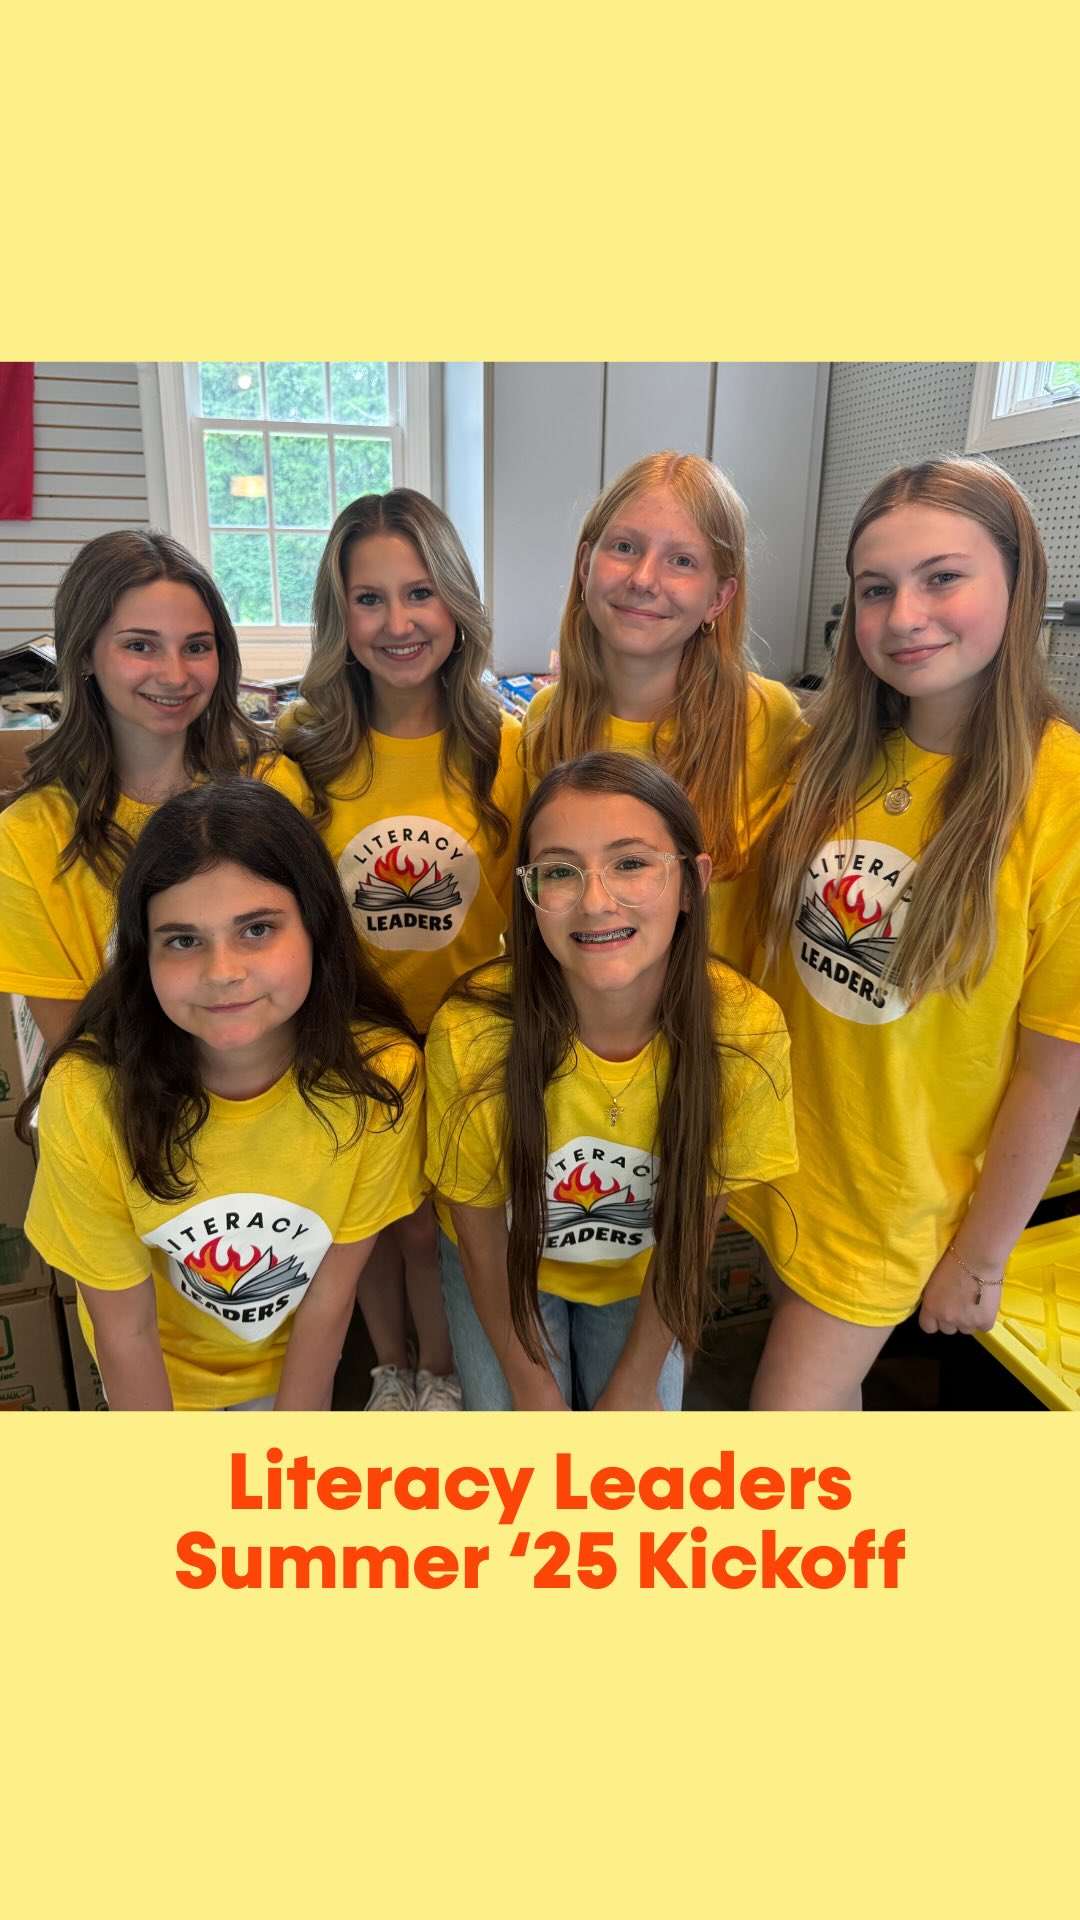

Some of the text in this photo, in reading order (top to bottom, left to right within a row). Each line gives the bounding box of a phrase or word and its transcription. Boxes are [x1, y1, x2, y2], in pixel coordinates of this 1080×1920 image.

[353, 828, 463, 864] LITERACY
[366, 913, 453, 931] LEADERS
[800, 942, 889, 1009] LEADERS
[543, 1148, 660, 1186] ITERAC
[167, 1212, 309, 1254] ITERACY
[545, 1226, 643, 1248] EADERS
[180, 1279, 290, 1323] LEADERS
